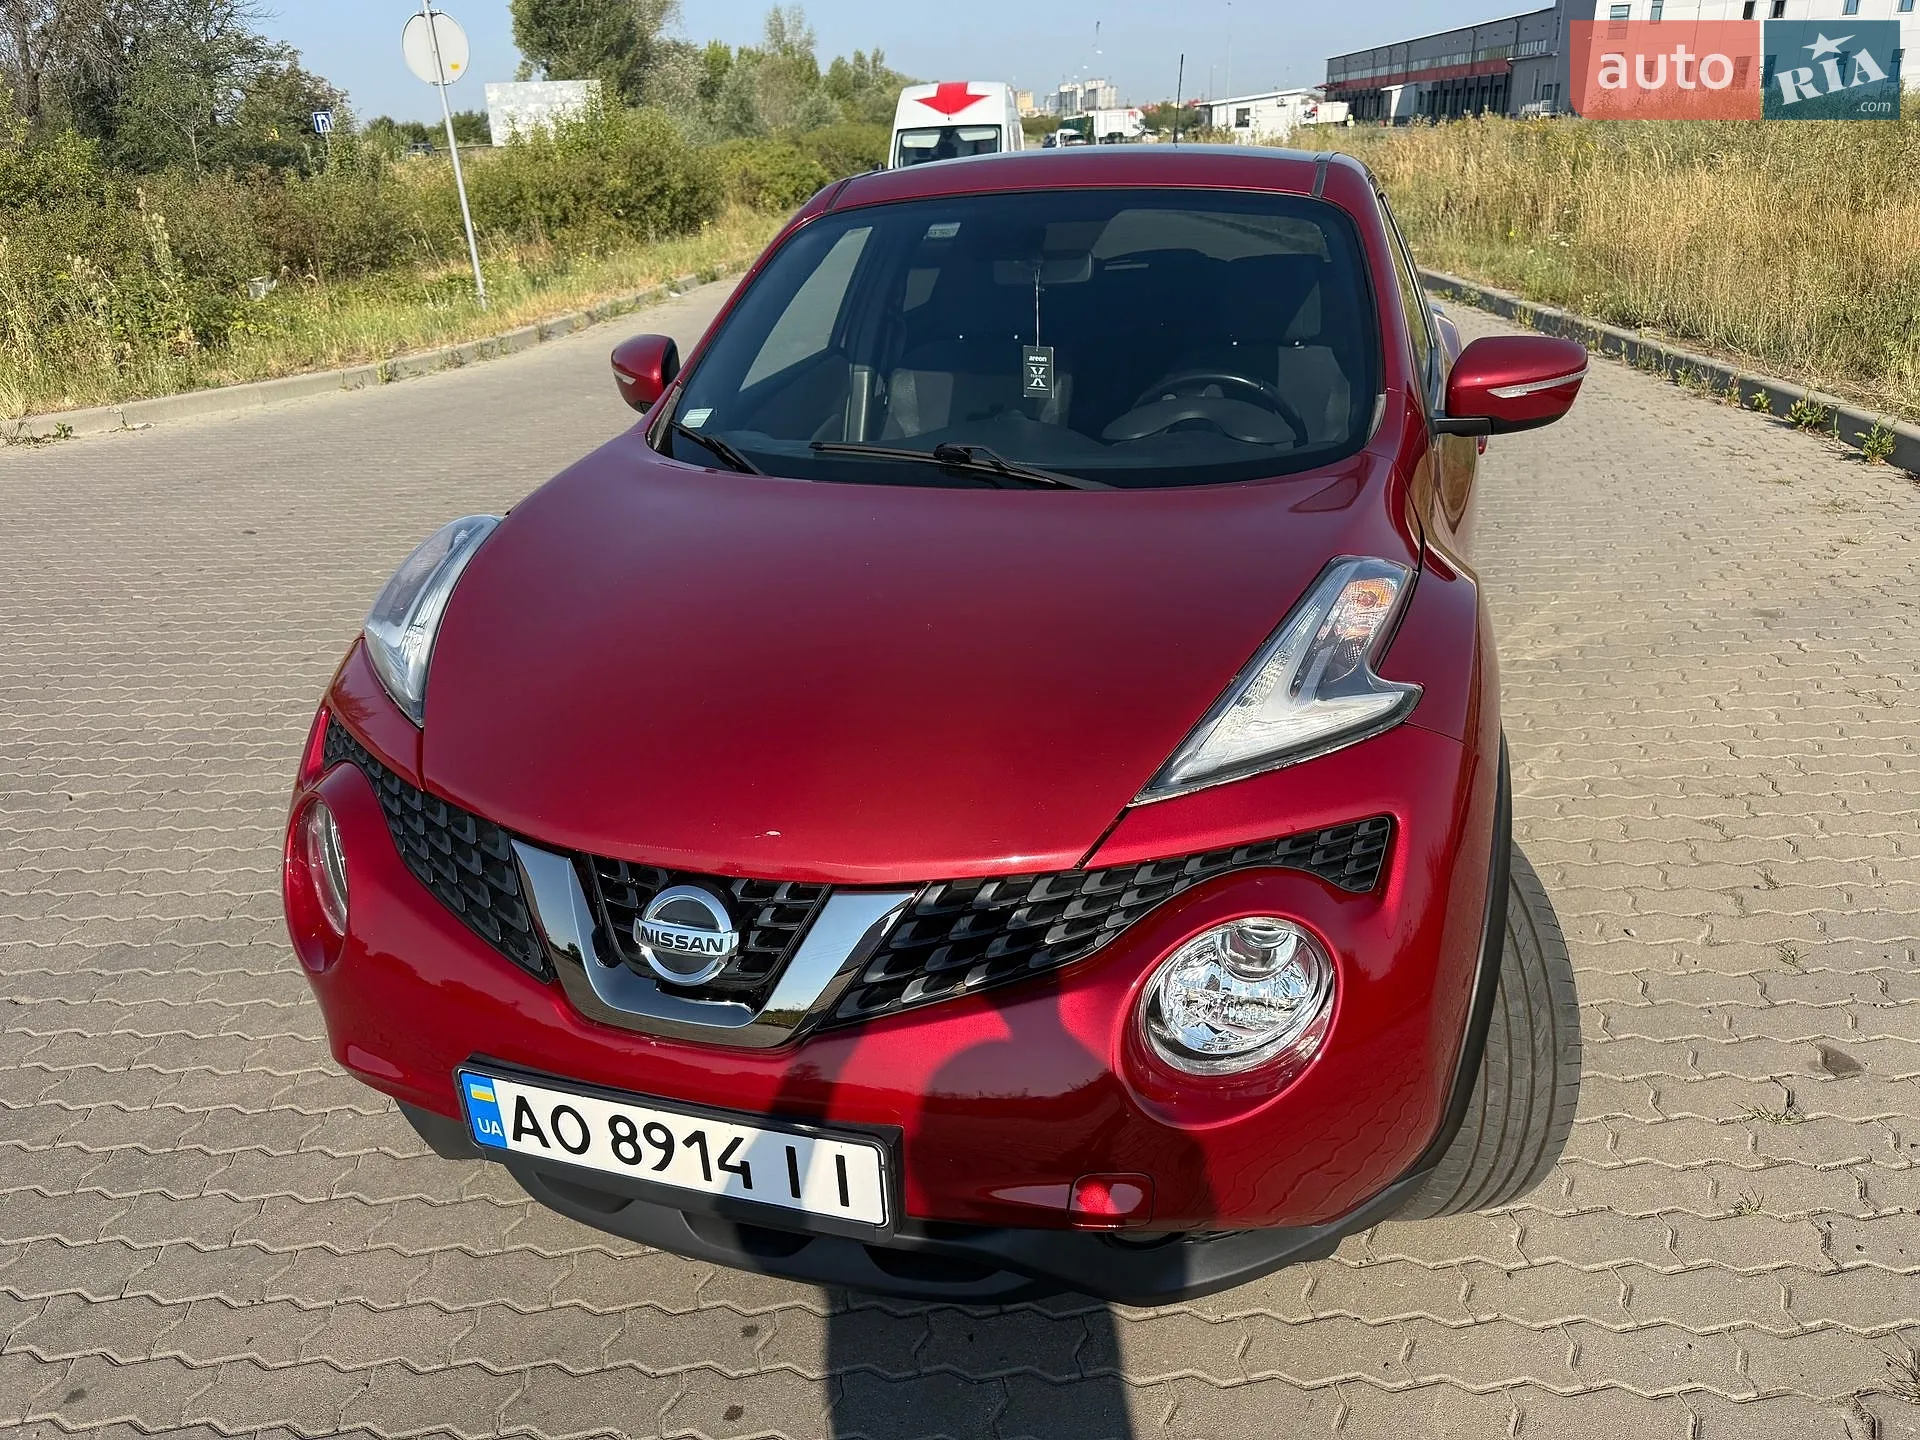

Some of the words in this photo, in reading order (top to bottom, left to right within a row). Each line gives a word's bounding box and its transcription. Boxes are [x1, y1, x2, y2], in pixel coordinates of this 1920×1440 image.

[639, 925, 724, 953] NISSAN
[478, 1117, 502, 1137] UA
[512, 1095, 592, 1155] AO
[607, 1113, 753, 1191] 8914
